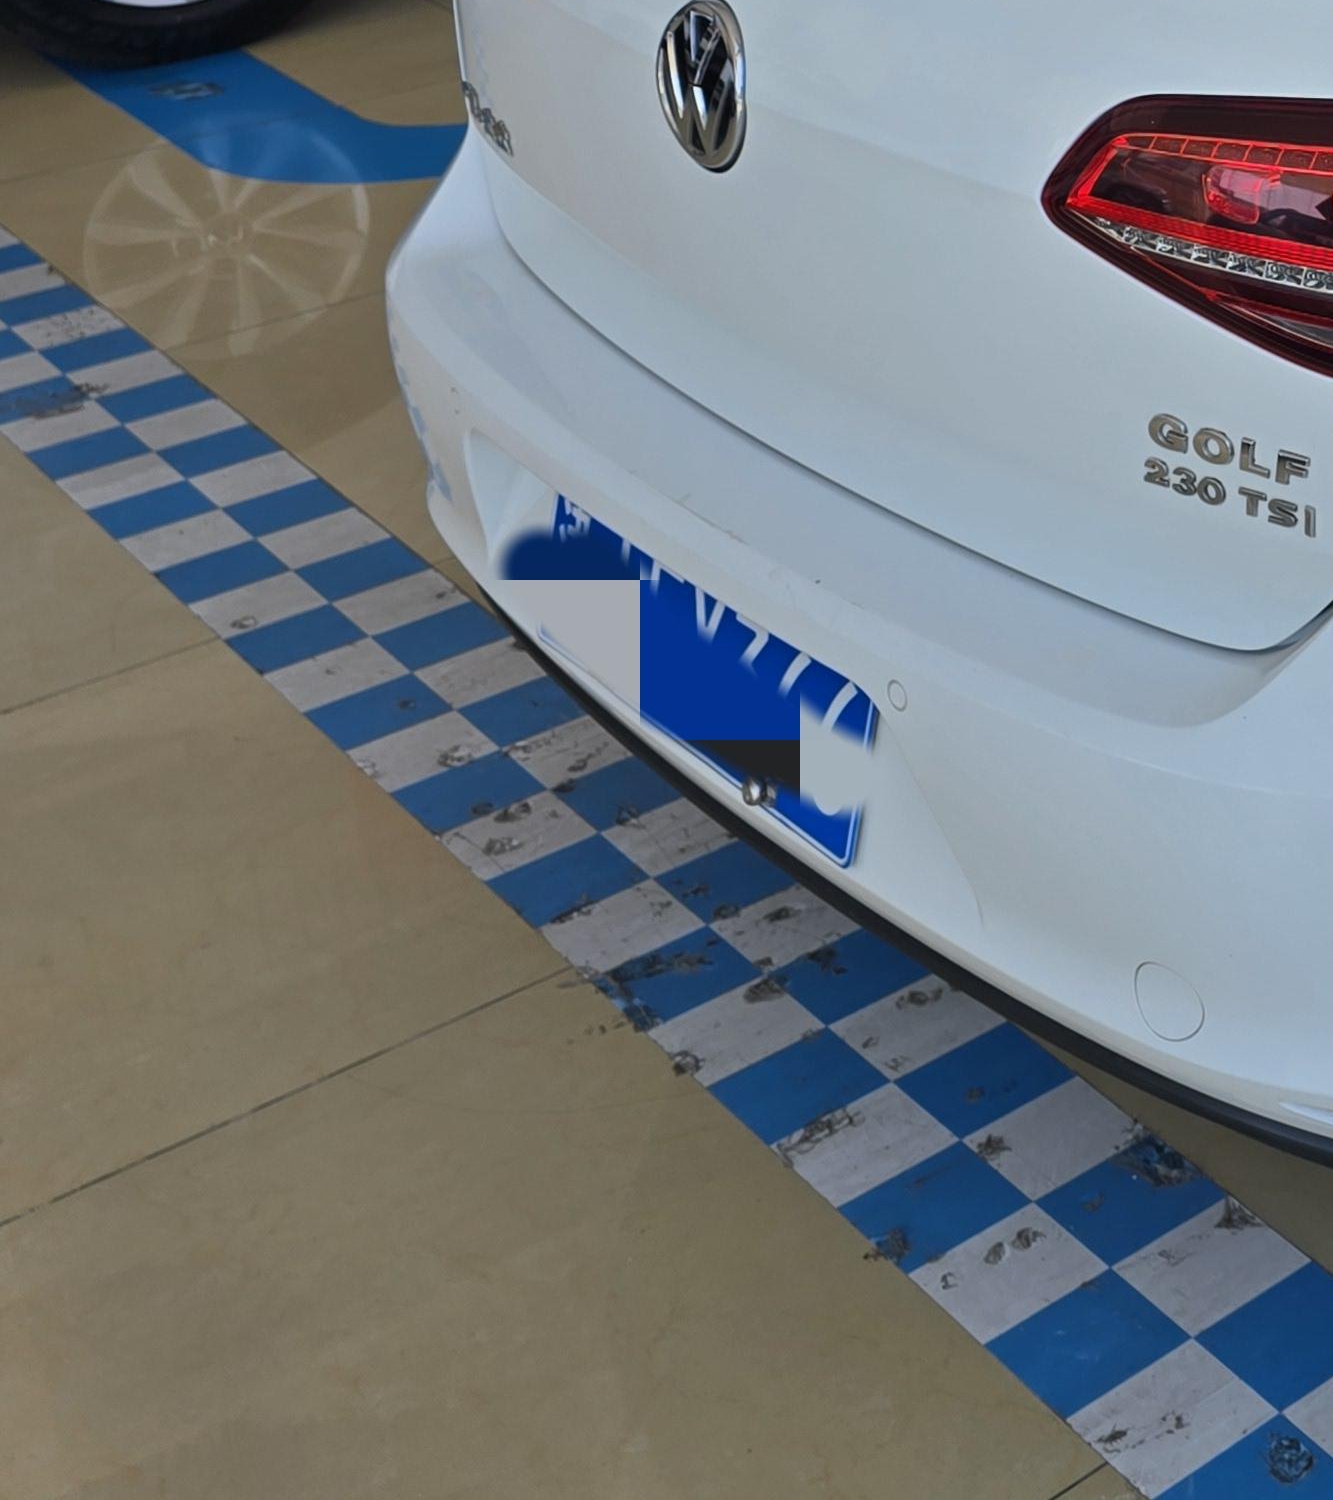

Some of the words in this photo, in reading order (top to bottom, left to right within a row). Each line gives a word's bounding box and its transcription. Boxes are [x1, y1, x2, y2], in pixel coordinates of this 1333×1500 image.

[1148, 412, 1312, 486] GOLF
[1143, 457, 1226, 507] 230
[1237, 486, 1318, 538] TSI
